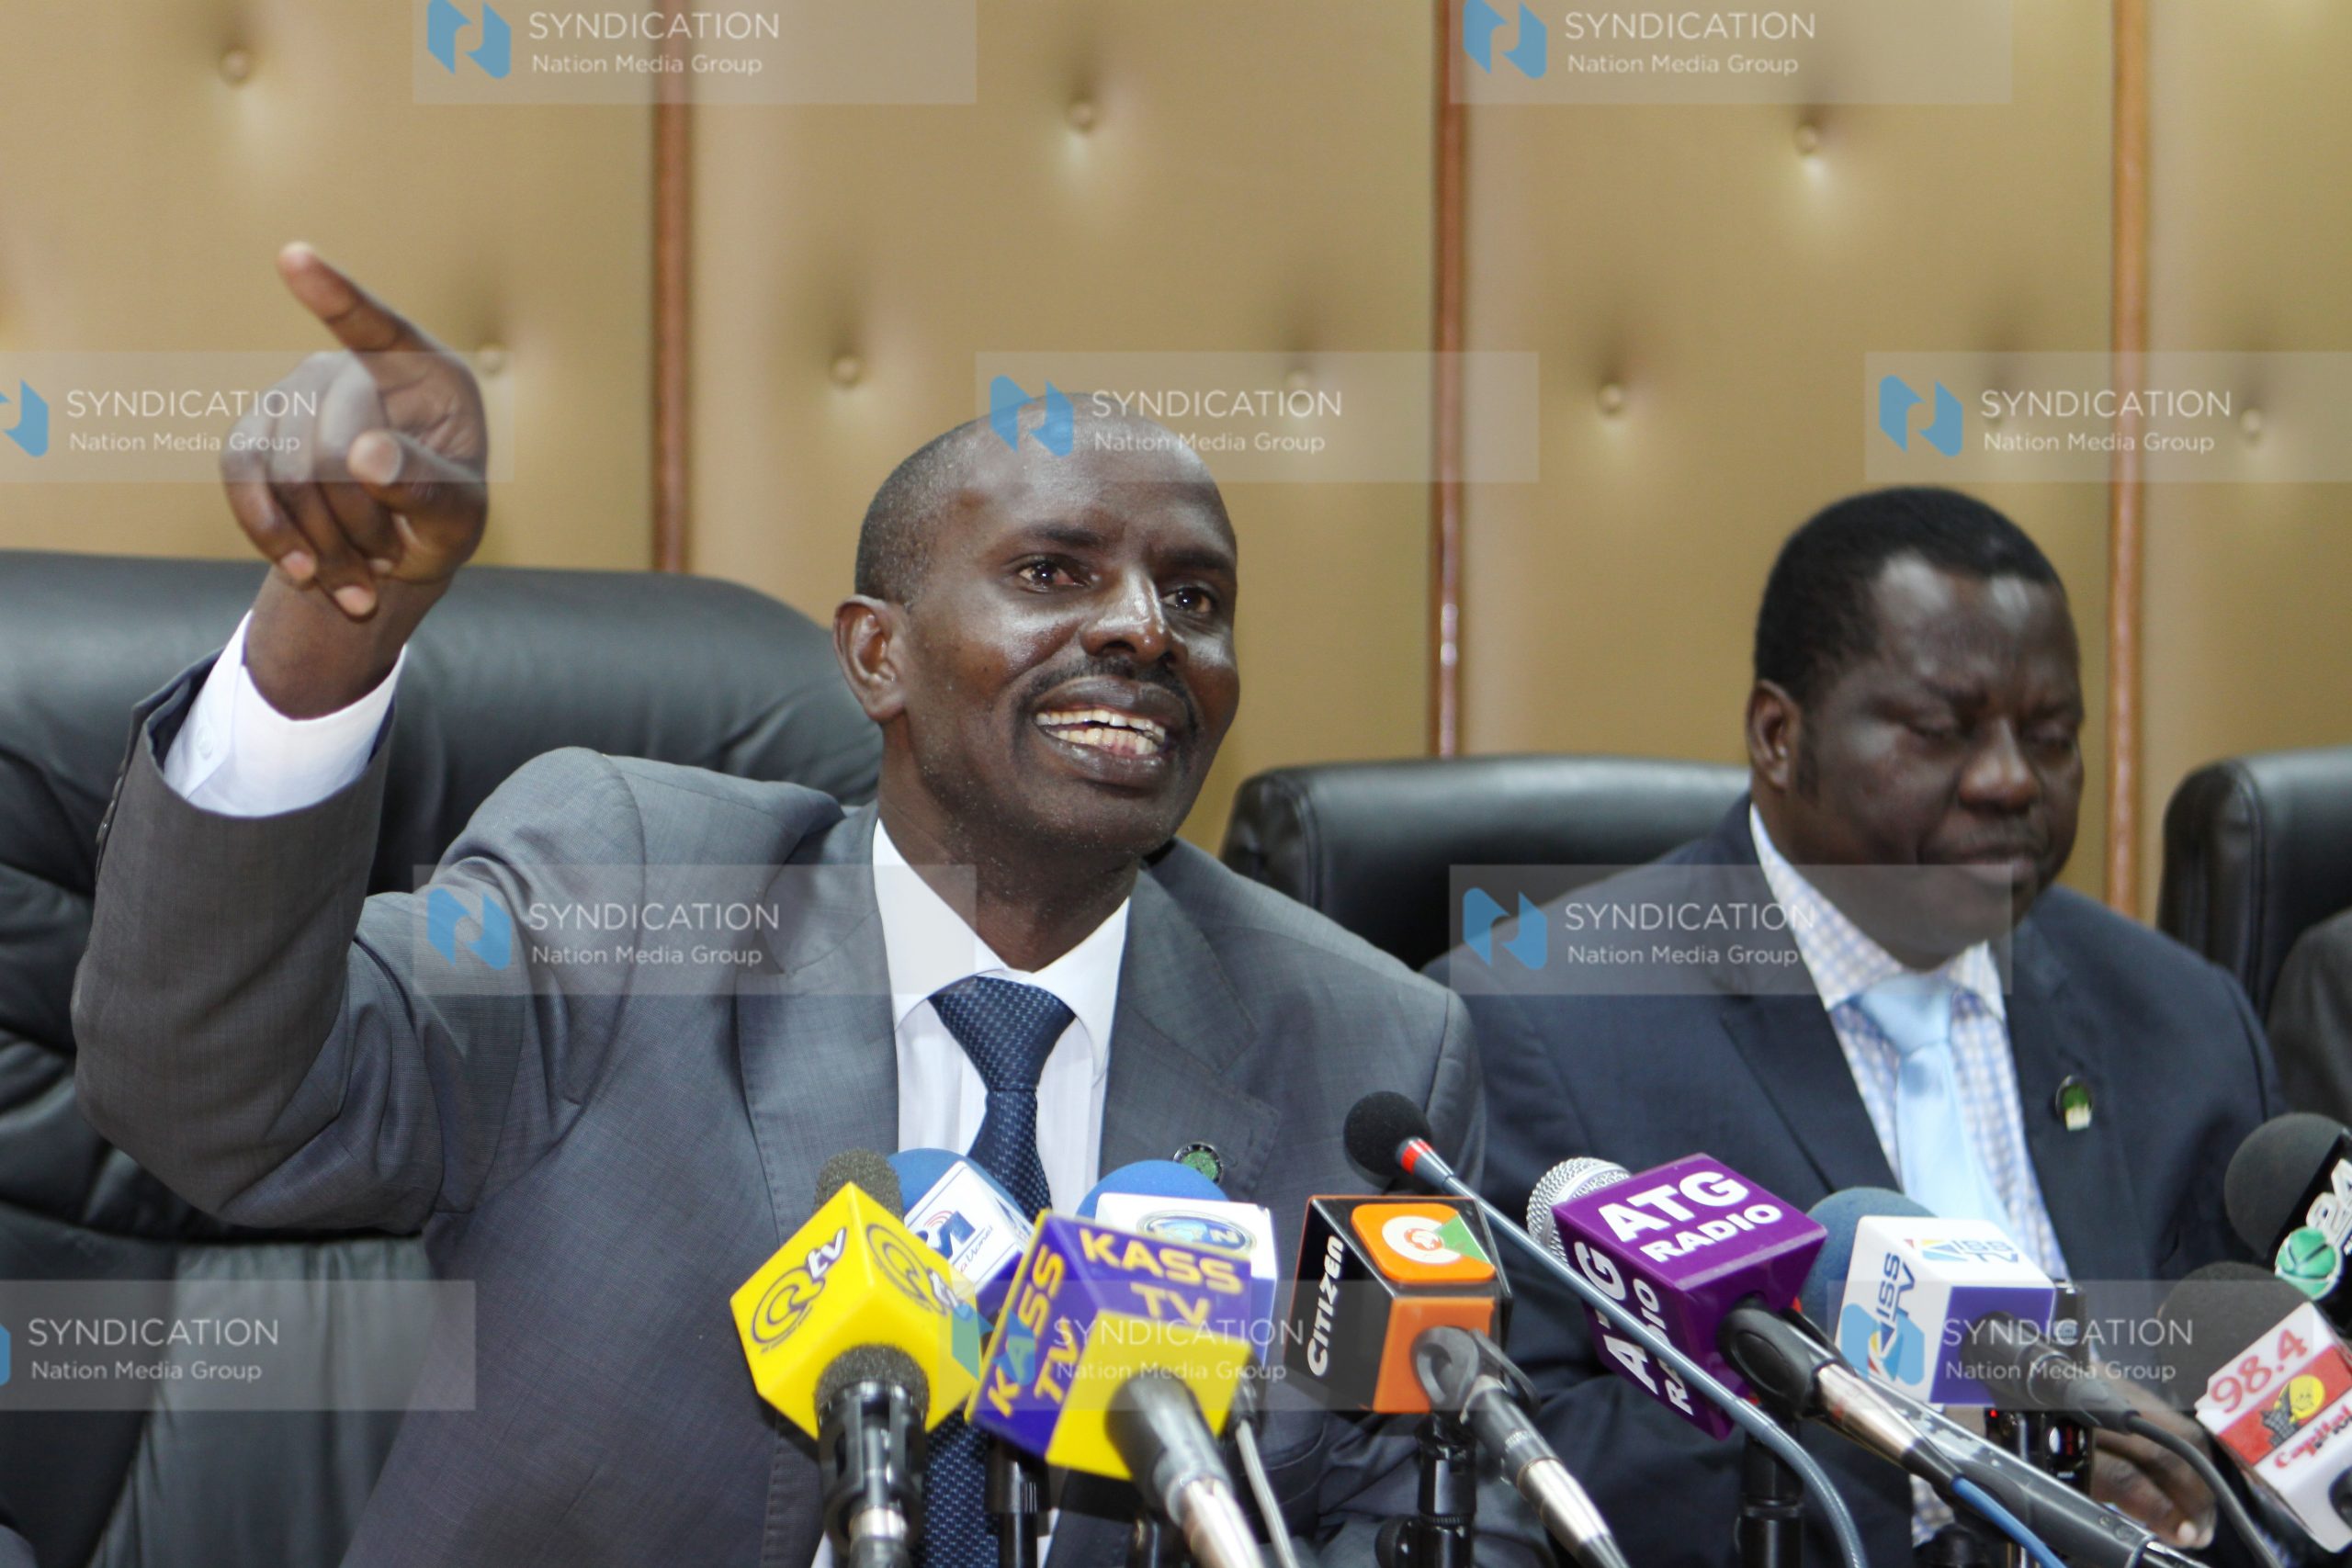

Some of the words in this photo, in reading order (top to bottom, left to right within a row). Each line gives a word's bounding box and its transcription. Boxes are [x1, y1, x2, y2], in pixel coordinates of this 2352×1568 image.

[1599, 1170, 1750, 1244] ATG
[1640, 1203, 1784, 1263] RADIO
[1080, 1228, 1244, 1295] KASS
[988, 1245, 1065, 1418] KASS
[1130, 1281, 1210, 1325] TV
[1574, 1241, 1659, 1396] AG
[1034, 1315, 1080, 1404] TV
[2211, 1329, 2308, 1414] 98.4
